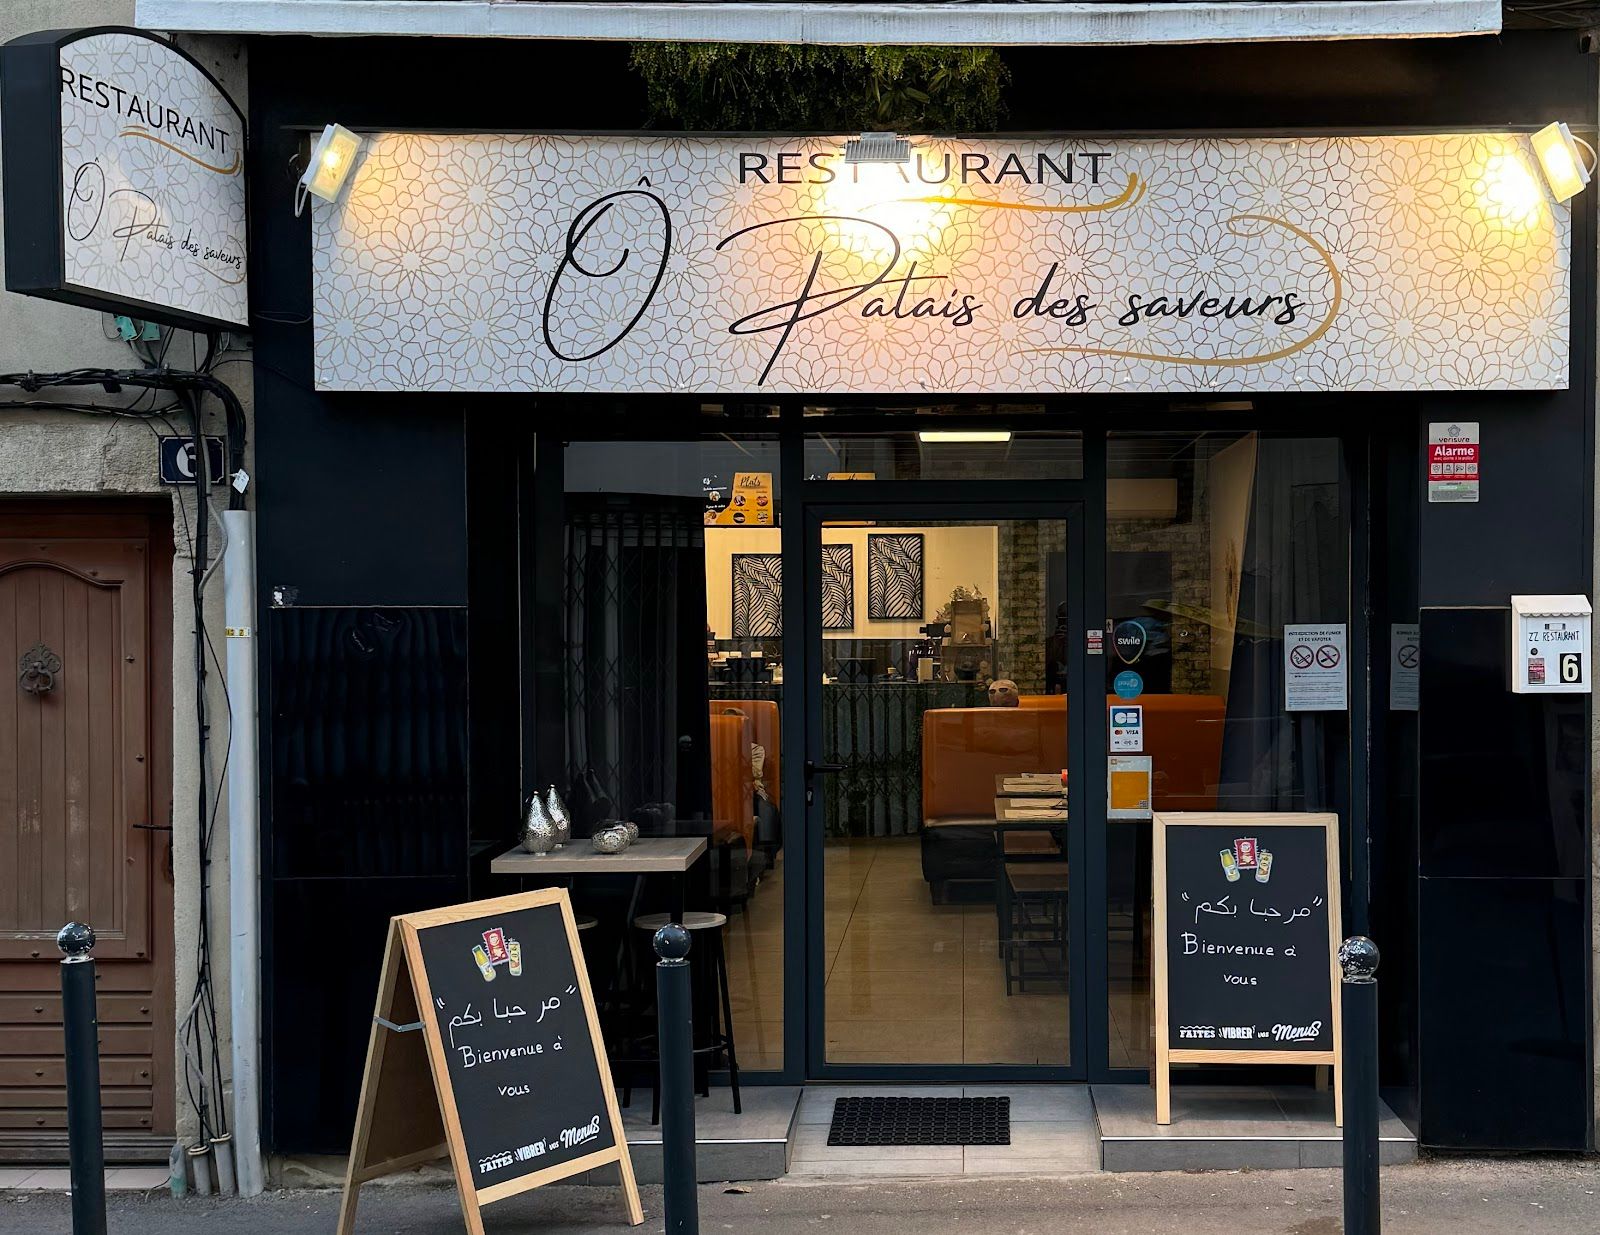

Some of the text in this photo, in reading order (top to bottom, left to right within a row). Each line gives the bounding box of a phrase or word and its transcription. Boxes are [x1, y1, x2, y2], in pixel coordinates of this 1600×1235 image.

[60, 65, 229, 155] RESTAURANT
[738, 151, 1112, 185] RESTURANT
[108, 188, 175, 263] Palais
[181, 228, 200, 257] des
[203, 244, 242, 270] saveurs
[715, 215, 983, 387] Palais
[1012, 261, 1098, 328] des
[1118, 289, 1307, 328] saveurs
[1434, 446, 1474, 456] Alarme
[740, 475, 762, 488] Plats
[1117, 636, 1141, 646] swile
[1529, 631, 1580, 641] ZZ RESTAURANT
[1563, 654, 1578, 681] 6
[1180, 931, 1275, 956] Bienvenue
[1223, 974, 1258, 986] vous
[1179, 1028, 1216, 1039] FAITES
[1221, 1026, 1254, 1040] VIBRER
[458, 1035, 563, 1068] Bienvenue à
[497, 1083, 531, 1097] vous
[479, 1153, 514, 1174] FAITES
[516, 1140, 546, 1162] VIBRER
